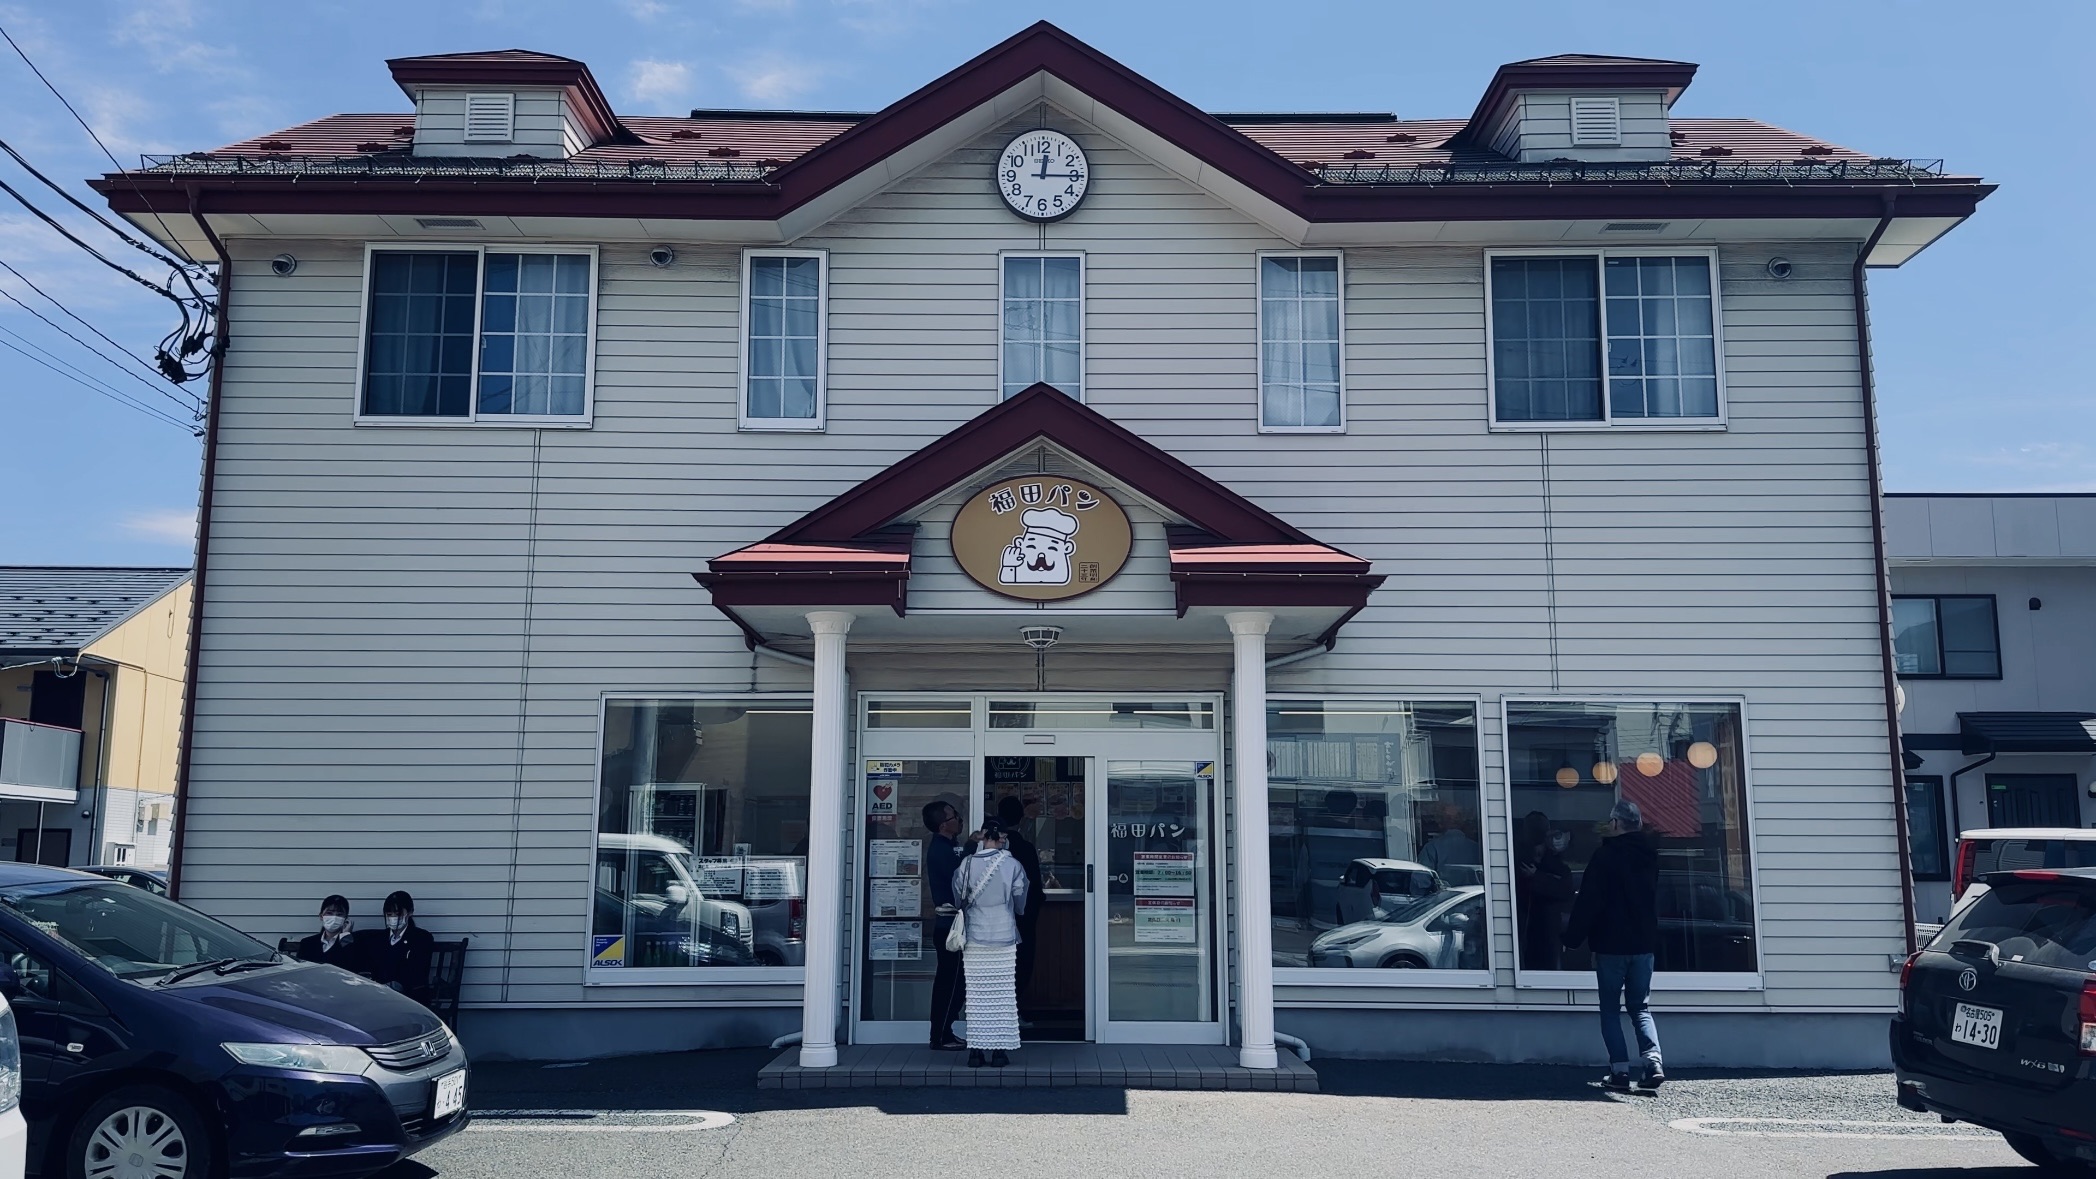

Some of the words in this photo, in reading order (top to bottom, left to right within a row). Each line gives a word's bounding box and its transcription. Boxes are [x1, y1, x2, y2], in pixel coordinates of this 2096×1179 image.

[1024, 144, 1034, 157] 11
[1037, 140, 1051, 154] 12
[1057, 144, 1061, 157] 1
[1010, 155, 1024, 168] 10
[1065, 154, 1075, 167] 2
[1006, 169, 1017, 182] 9
[1069, 169, 1079, 182] 3
[1011, 183, 1022, 196] 8
[1064, 184, 1075, 197] 4
[1023, 195, 1034, 208] 7
[1037, 198, 1048, 212] 6
[1052, 195, 1063, 208] 5
[988, 483, 1099, 515] 福田パン
[872, 802, 893, 811] AED
[1110, 822, 1186, 838] 福田パン
[592, 959, 623, 967] ALSOK
[1954, 1022, 1962, 1033] わ
